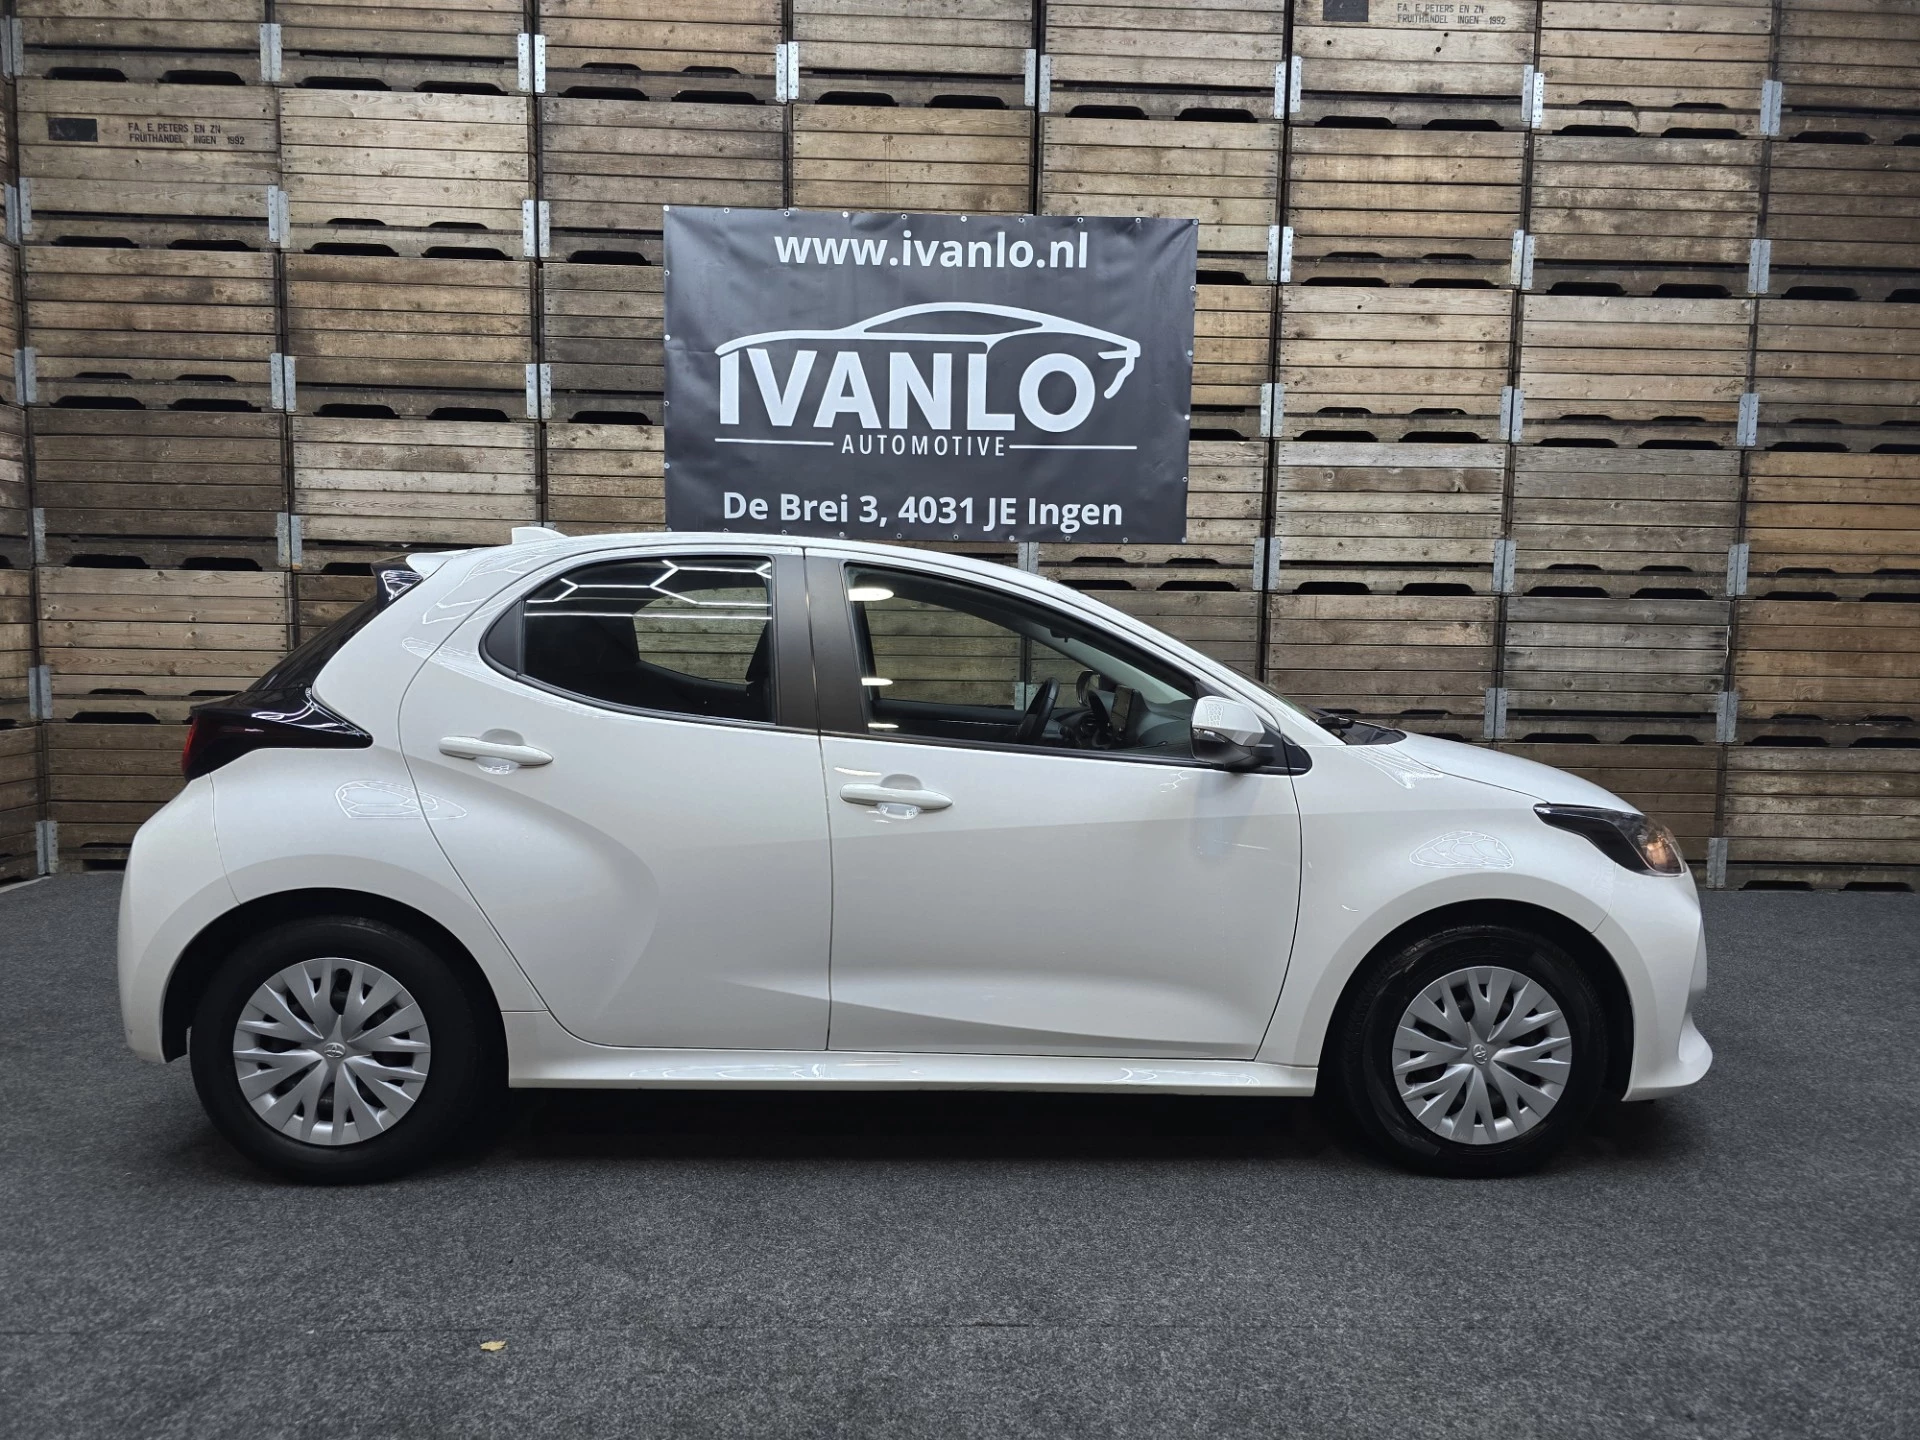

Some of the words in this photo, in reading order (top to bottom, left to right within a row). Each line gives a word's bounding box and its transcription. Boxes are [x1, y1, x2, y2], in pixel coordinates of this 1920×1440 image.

[1425, 3, 1454, 13] PETERS
[1459, 4, 1470, 14] EN
[1474, 5, 1485, 14] ZN
[1397, 14, 1449, 24] FRUITHANDEL
[1457, 15, 1480, 25] INGEN
[1489, 16, 1506, 25] 1992
[158, 123, 189, 133] PETERS
[194, 124, 205, 133] EN
[210, 124, 221, 134] ZN
[129, 133, 184, 144] FRUITHANDEL
[194, 135, 217, 145] INGEN
[227, 136, 245, 145] 1992
[773, 229, 1088, 270] www.ivanlo.nl
[718, 347, 1096, 433] IVANLO
[840, 433, 1006, 457] AUTOMOTIVE
[723, 490, 769, 521] De
[779, 493, 849, 524] Brei
[859, 495, 888, 528] 3,
[898, 496, 974, 525] 4031
[983, 497, 1017, 532] JE
[1028, 497, 1123, 534] Ingen
